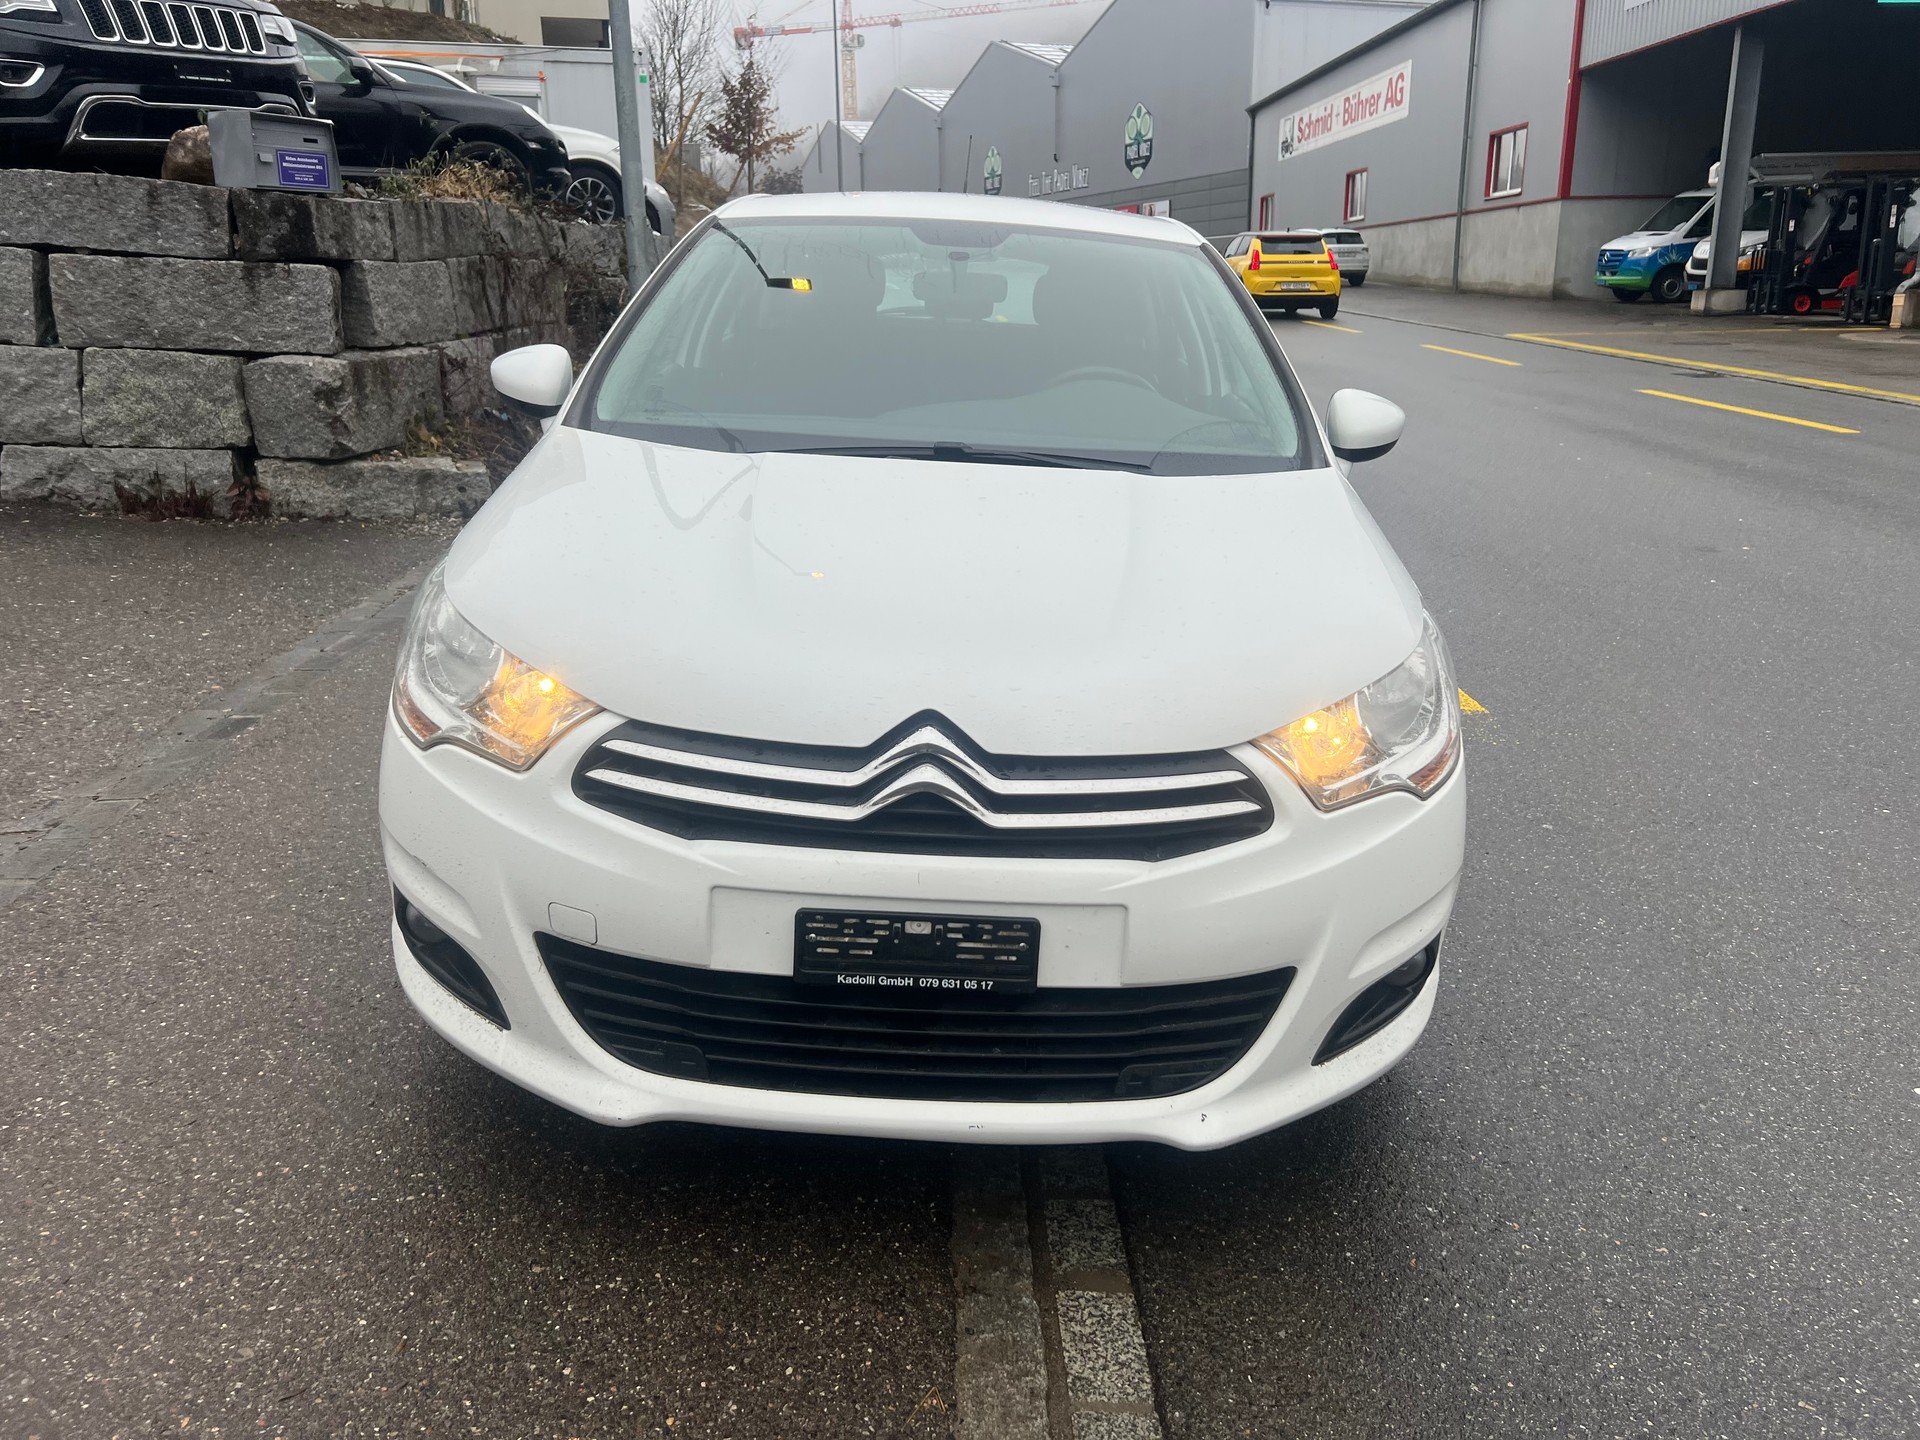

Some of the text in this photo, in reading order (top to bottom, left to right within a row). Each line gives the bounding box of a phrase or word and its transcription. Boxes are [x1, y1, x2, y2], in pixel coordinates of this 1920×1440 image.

[1297, 103, 1333, 144] Schmid
[1342, 91, 1381, 127] Bührer
[1384, 71, 1405, 111] AG
[837, 974, 994, 990] Kadolli GmbH 079 631 05 17
